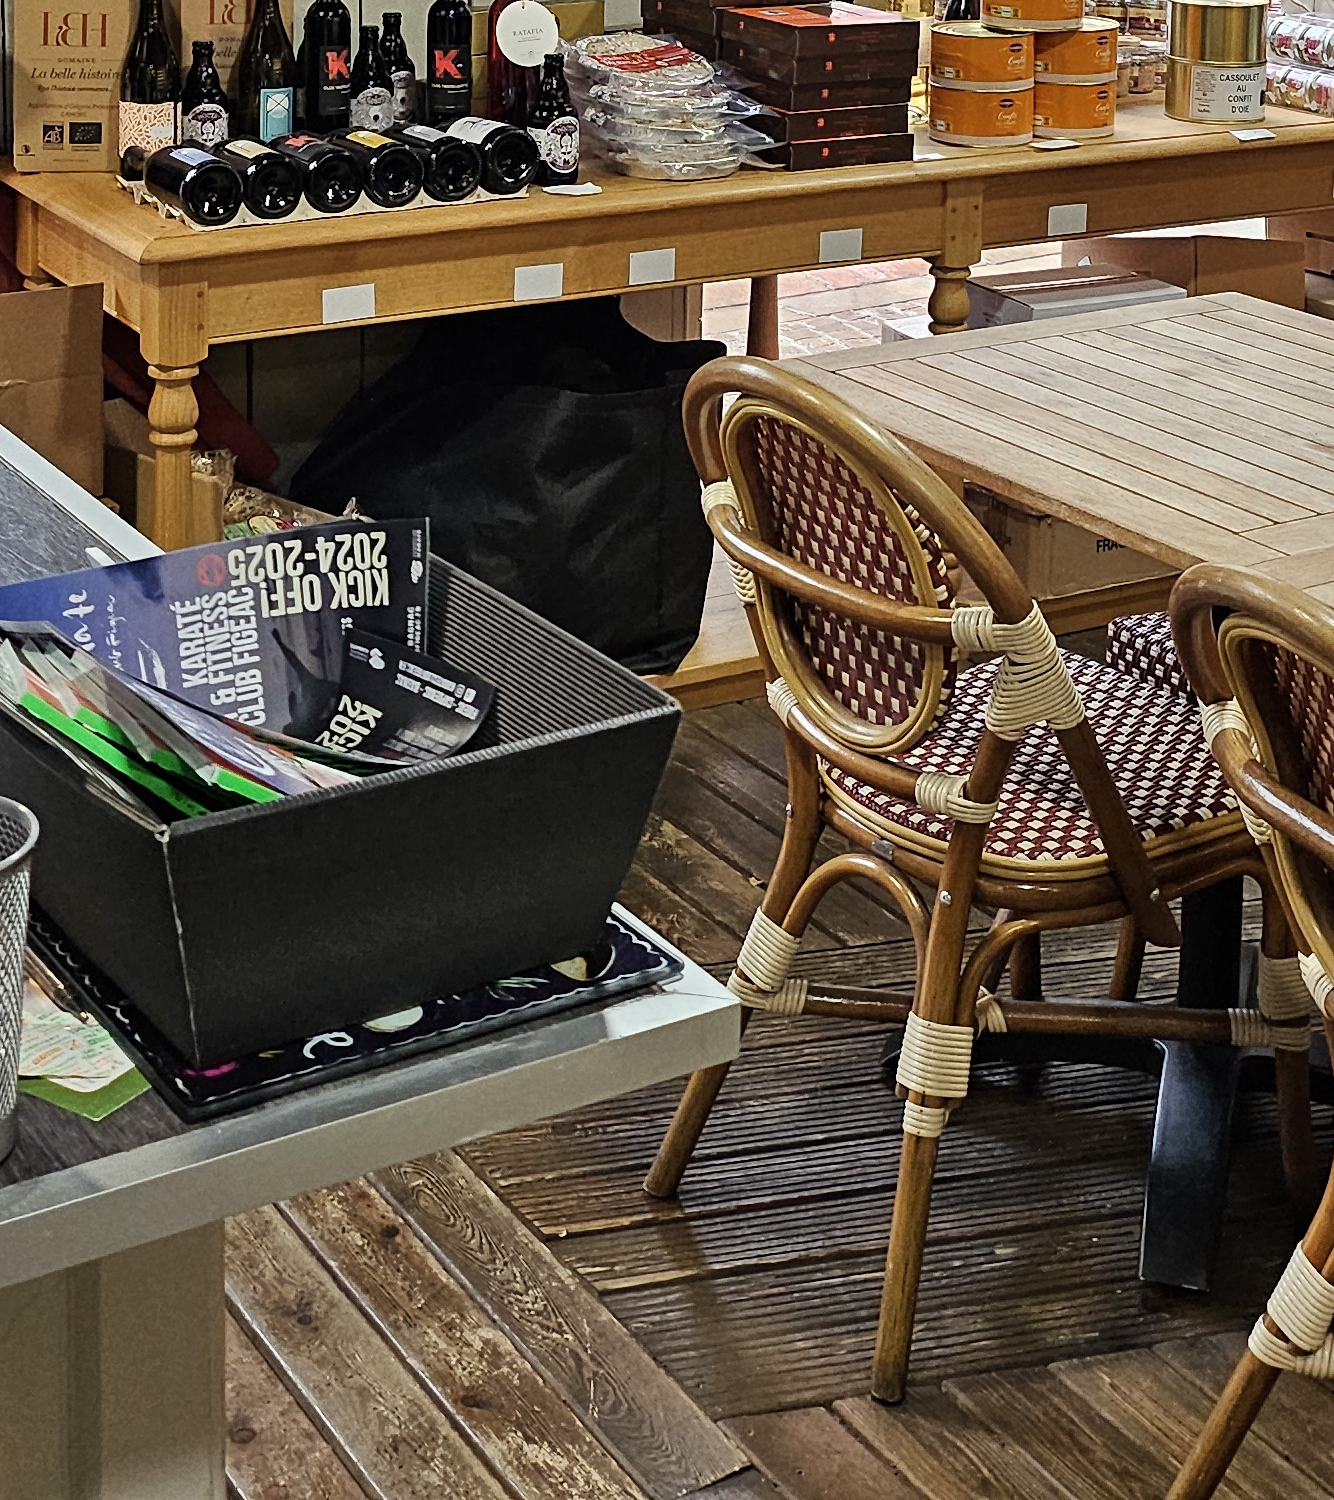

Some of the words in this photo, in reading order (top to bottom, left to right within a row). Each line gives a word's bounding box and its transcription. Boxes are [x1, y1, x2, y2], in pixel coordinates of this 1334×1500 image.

[512, 28, 544, 37] RATAFIA
[30, 67, 49, 80] La
[49, 66, 77, 80] belle
[78, 66, 120, 80] histoir
[57, 56, 97, 64] DOMAINE
[325, 48, 351, 81] K
[433, 48, 463, 81] K
[1219, 72, 1260, 82] CASSOULET
[1236, 84, 1247, 92] AU
[1227, 94, 1253, 103] CONFIT
[1231, 105, 1250, 114] D'OIE
[227, 531, 388, 588] 2024-2025
[257, 572, 323, 618] OFF!
[327, 568, 390, 611] KICK
[200, 590, 236, 686] FITNESS
[225, 585, 262, 663] FIGEAC
[168, 595, 209, 689] KARATÉ
[233, 668, 267, 726] CLUB
